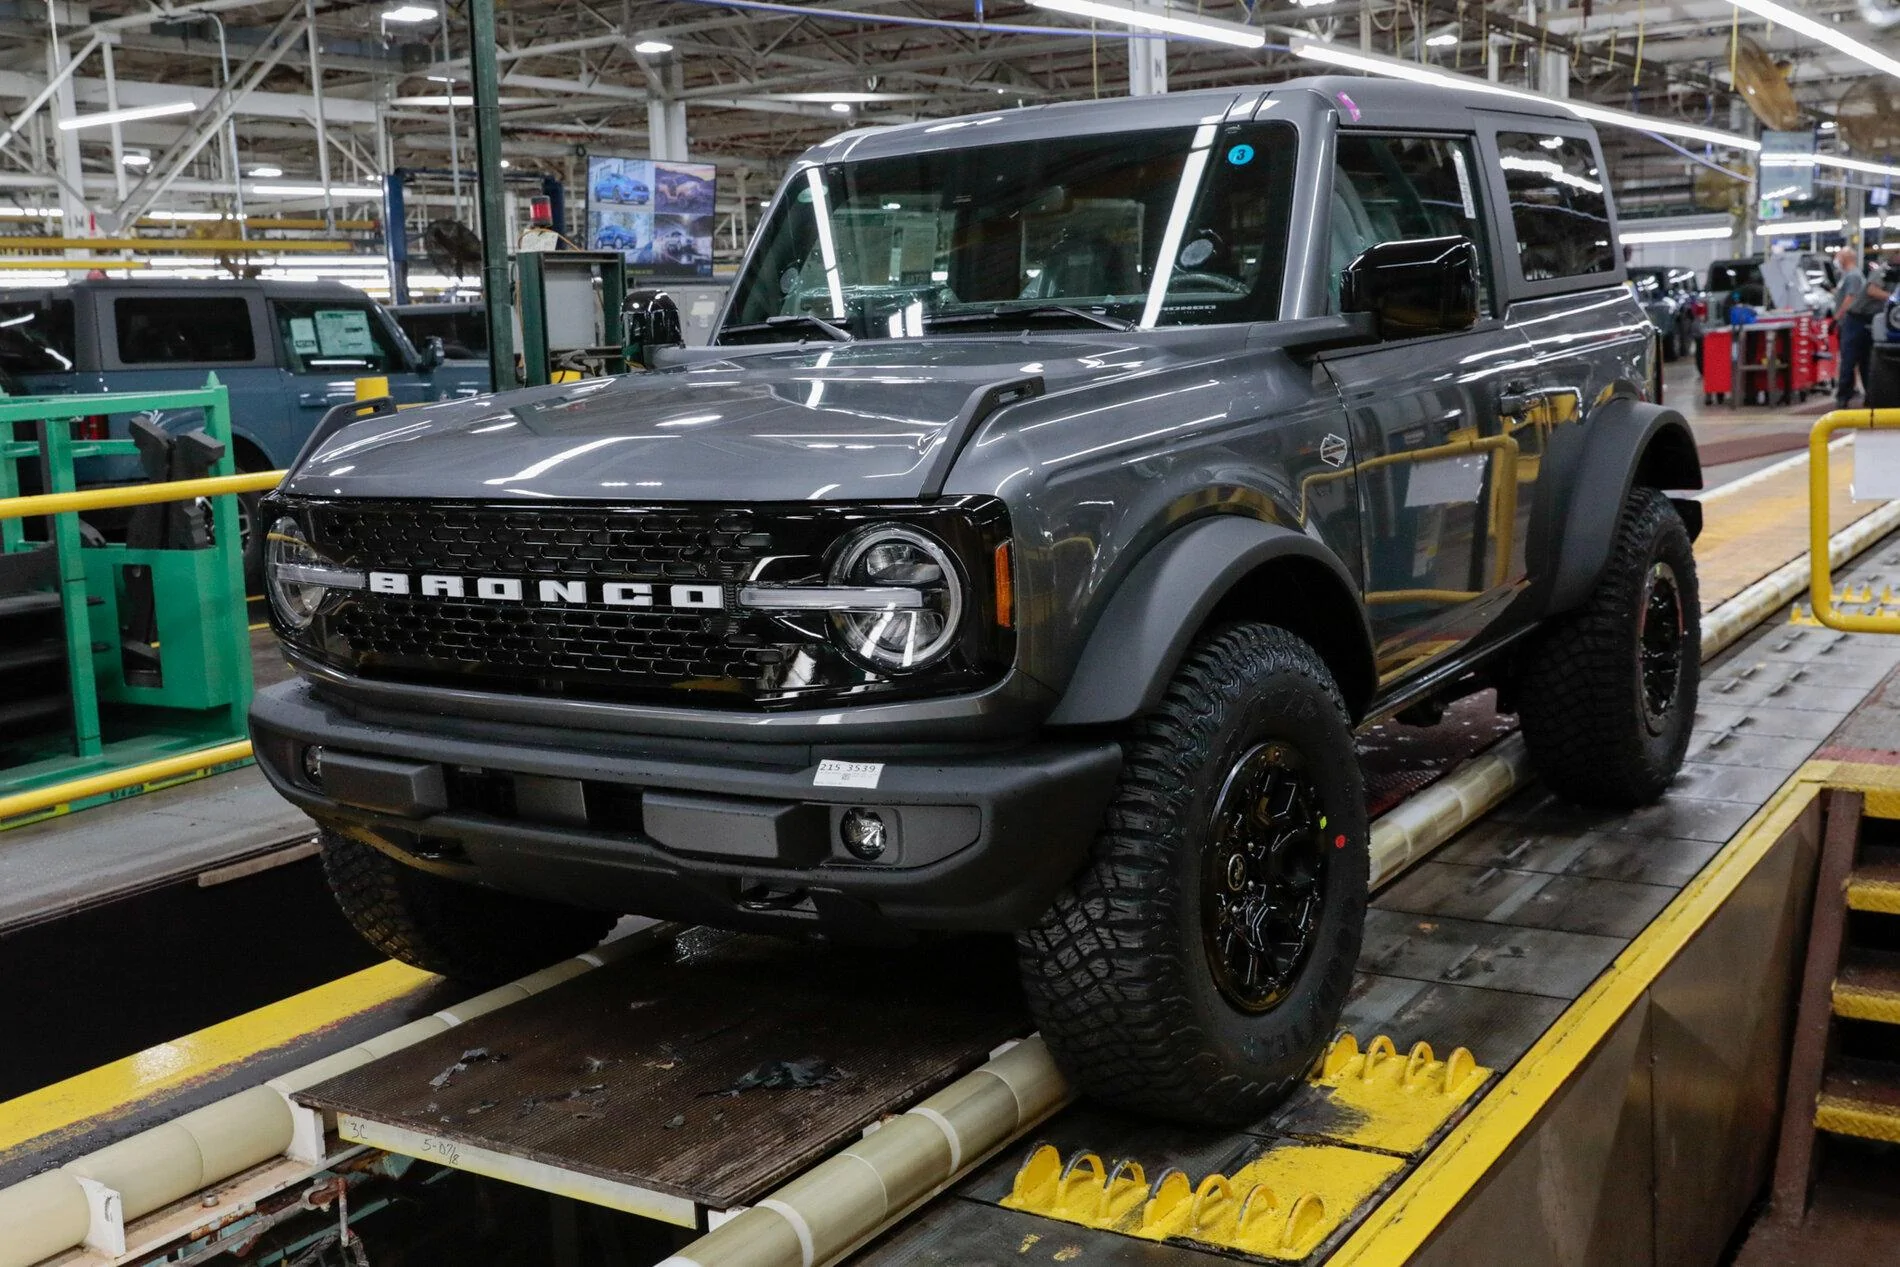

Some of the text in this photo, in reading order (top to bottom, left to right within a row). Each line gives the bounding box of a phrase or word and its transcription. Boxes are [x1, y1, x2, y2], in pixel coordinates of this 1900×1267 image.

[369, 570, 724, 609] BRONCO
[819, 763, 877, 773] 215 3539
